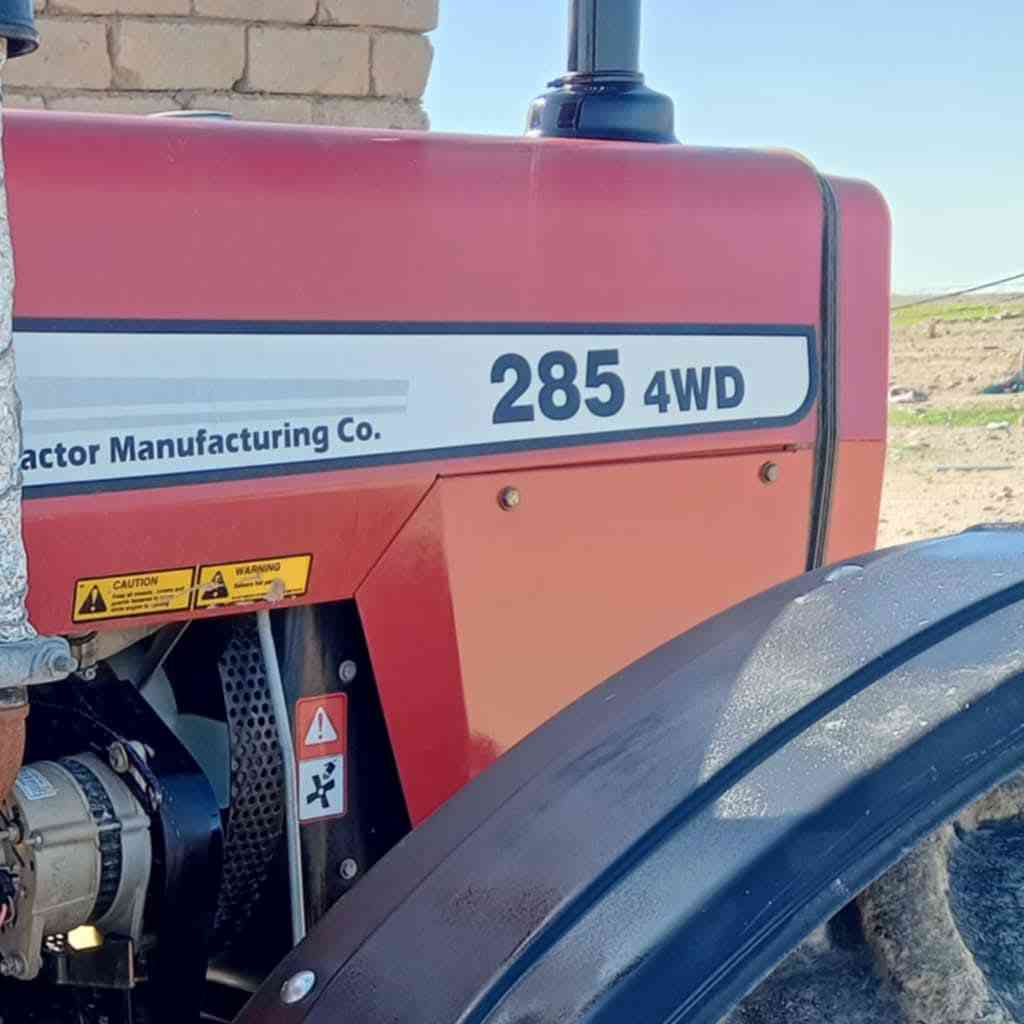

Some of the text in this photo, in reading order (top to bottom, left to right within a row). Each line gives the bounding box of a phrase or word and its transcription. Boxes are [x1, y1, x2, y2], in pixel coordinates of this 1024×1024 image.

[490, 348, 746, 424] 285 4WD
[20, 416, 382, 470] actor Manufacturing Co.
[112, 576, 159, 591] CAUTION
[235, 562, 281, 577] WARNING
